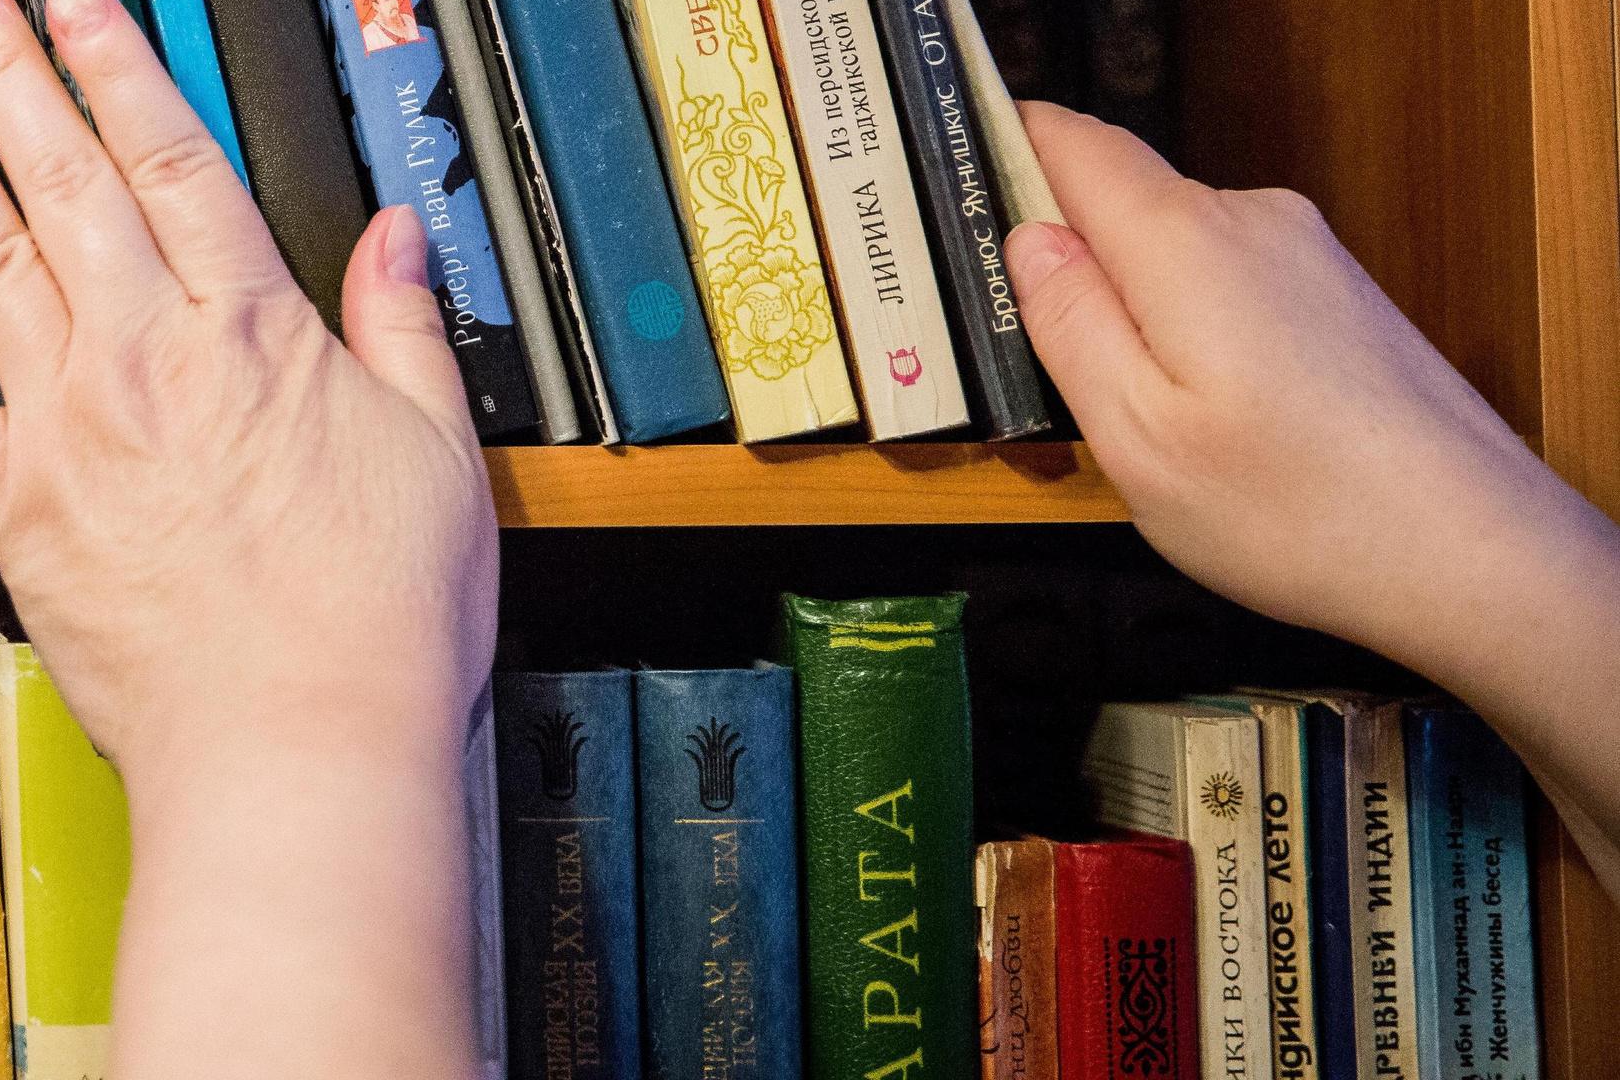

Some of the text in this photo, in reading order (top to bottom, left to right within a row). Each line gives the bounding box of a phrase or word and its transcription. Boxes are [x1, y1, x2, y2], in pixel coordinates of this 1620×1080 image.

[840, 10, 881, 156] таджикской
[921, 29, 948, 67] ОТ
[829, 127, 853, 162] Из
[943, 83, 989, 217] Яунишкис
[394, 80, 482, 348] Роберт Ван Гулик
[859, 179, 904, 305] ЛИРИКА
[973, 228, 1018, 333] Бронюс
[556, 831, 583, 895] ВЕКА
[1265, 791, 1291, 883] лето
[1482, 836, 1504, 907] бесед
[1216, 839, 1242, 1003] ВОСТОКА
[1363, 781, 1401, 1080] РЕВНЕЙ ИНДИИ
[1453, 894, 1478, 1017] Мухаммад
[1454, 1022, 1475, 1069] ибн
[1485, 911, 1510, 1062] Жемчужины
